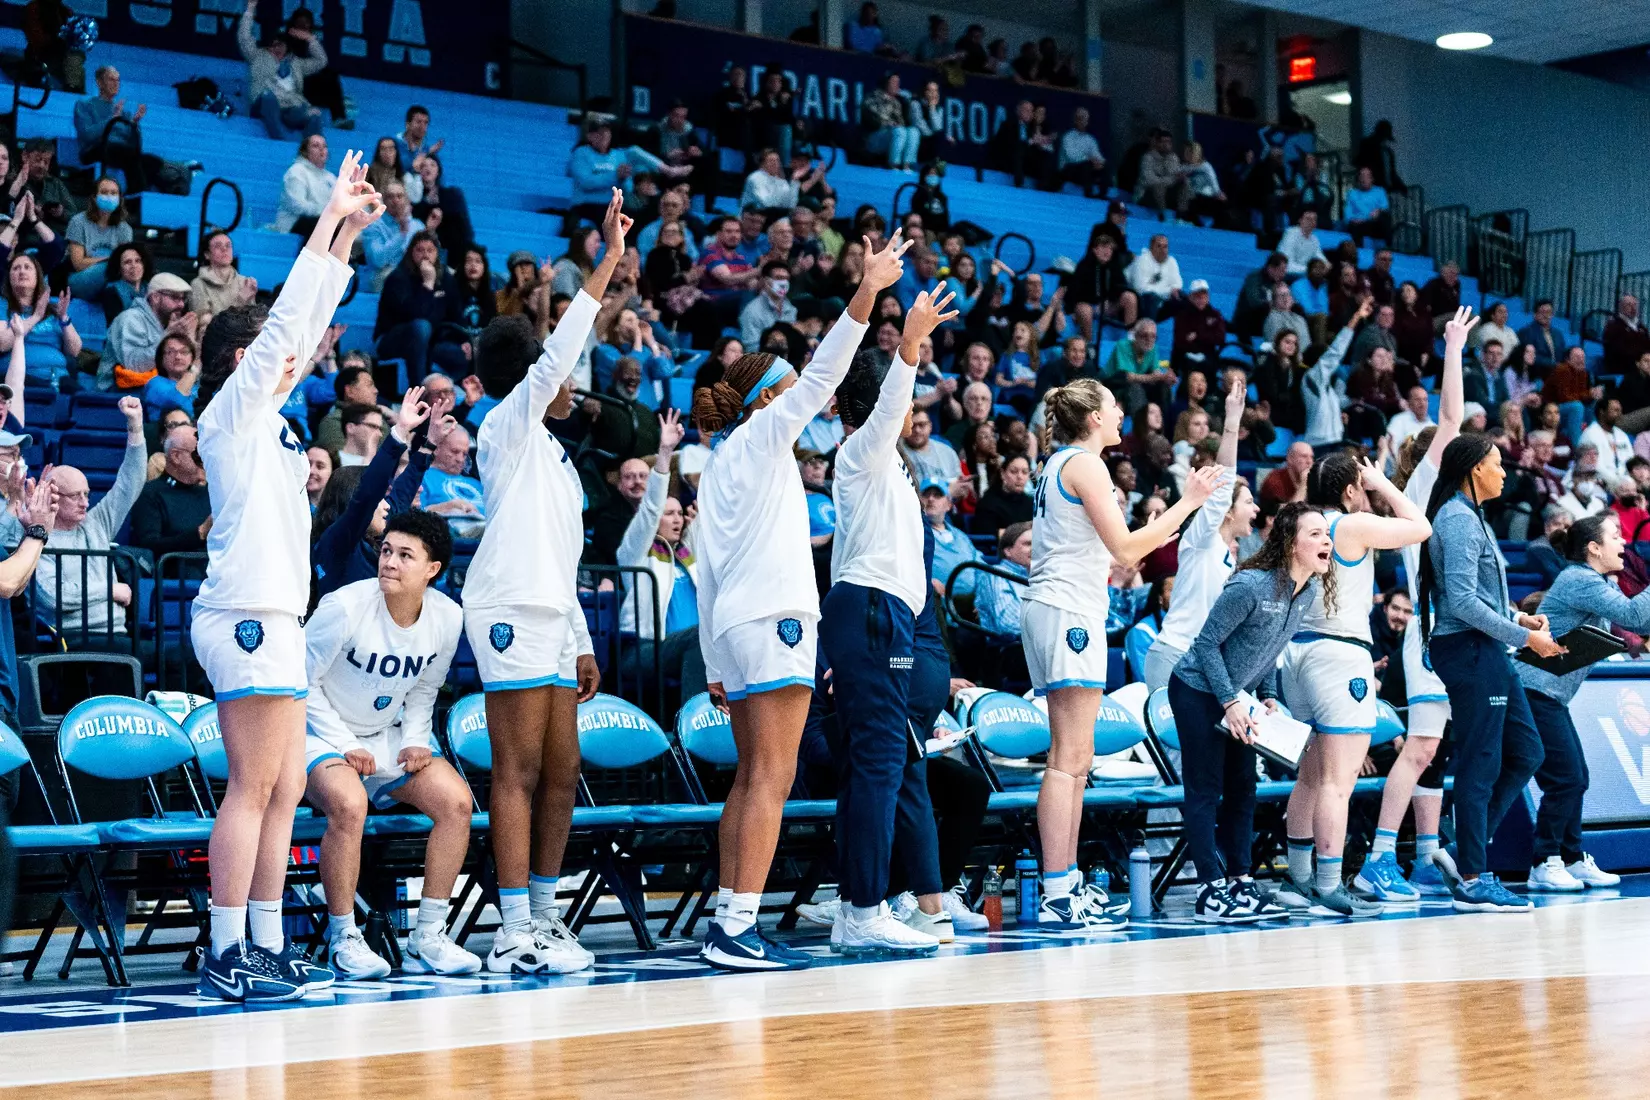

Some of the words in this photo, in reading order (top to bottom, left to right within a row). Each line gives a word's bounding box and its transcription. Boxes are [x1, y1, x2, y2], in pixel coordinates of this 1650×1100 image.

[75, 714, 170, 740] COLUMBIA
[577, 711, 650, 733] COLUMBIA
[983, 706, 1045, 726] COLUMBIA
